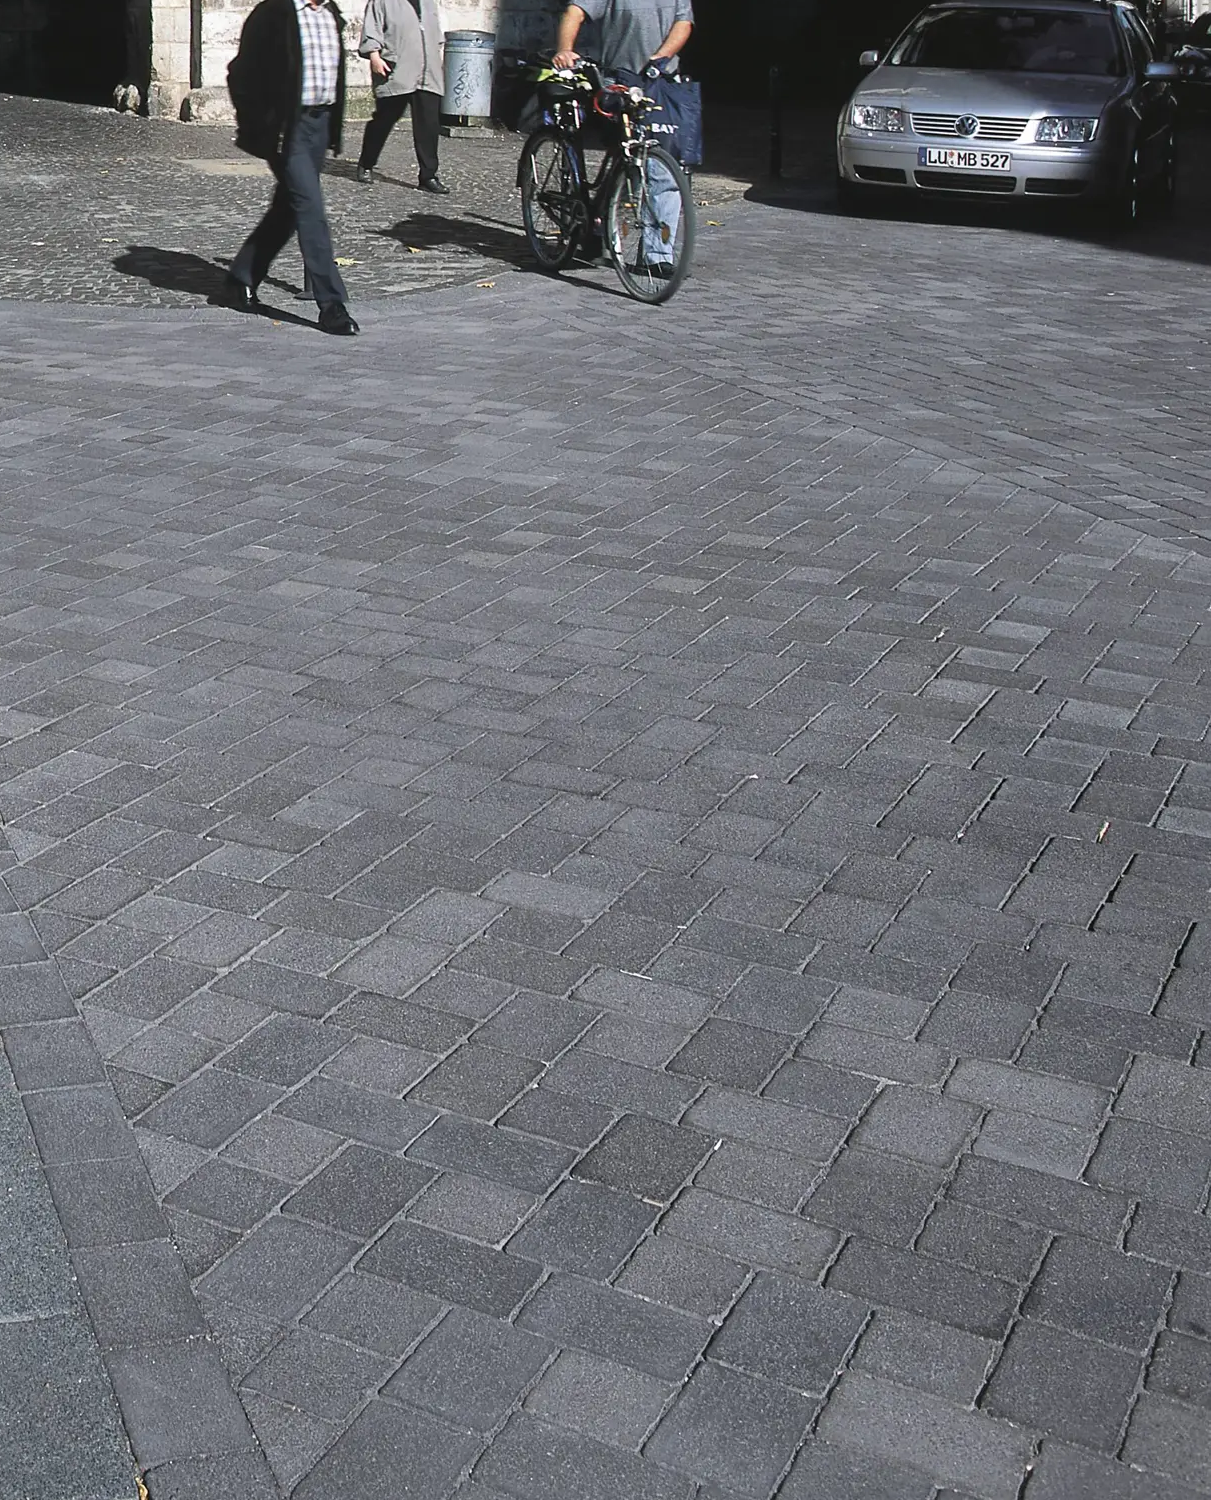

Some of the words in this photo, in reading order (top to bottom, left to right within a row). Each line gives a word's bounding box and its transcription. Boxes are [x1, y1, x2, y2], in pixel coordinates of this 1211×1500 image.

[928, 150, 947, 165] LU
[957, 152, 977, 167] MB
[980, 154, 1009, 168] 527
